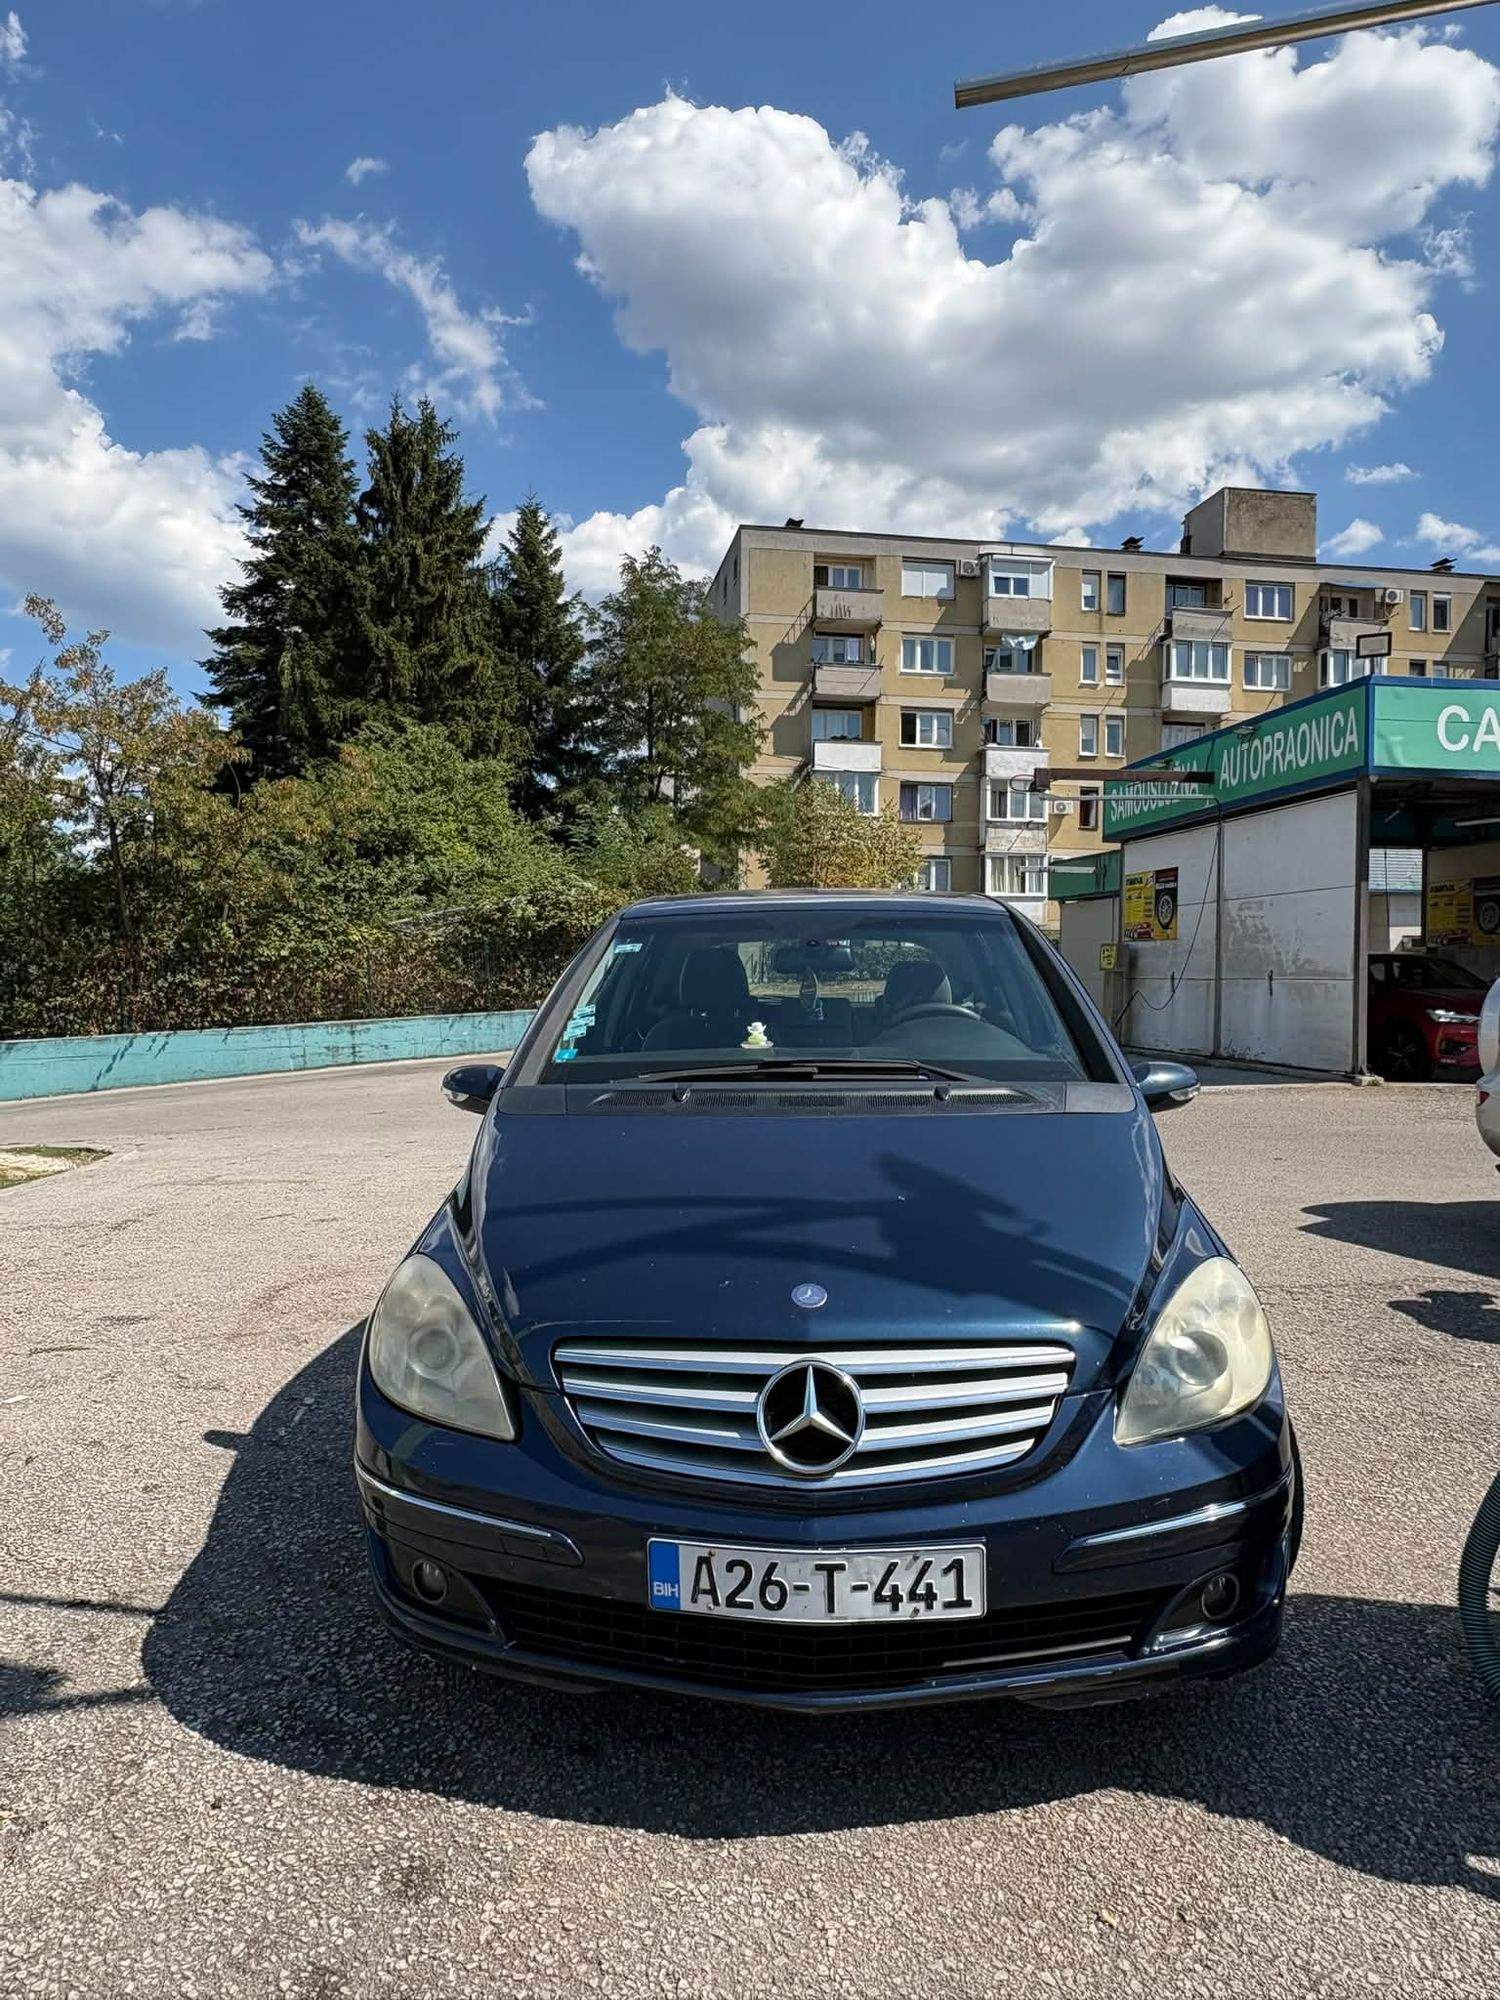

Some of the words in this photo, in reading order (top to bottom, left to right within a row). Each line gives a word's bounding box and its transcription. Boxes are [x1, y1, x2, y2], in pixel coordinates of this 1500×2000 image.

[1219, 706, 1359, 790] AUTOPRAONICA
[653, 1581, 679, 1598] BIH
[691, 1555, 973, 1614] A26-T-441
